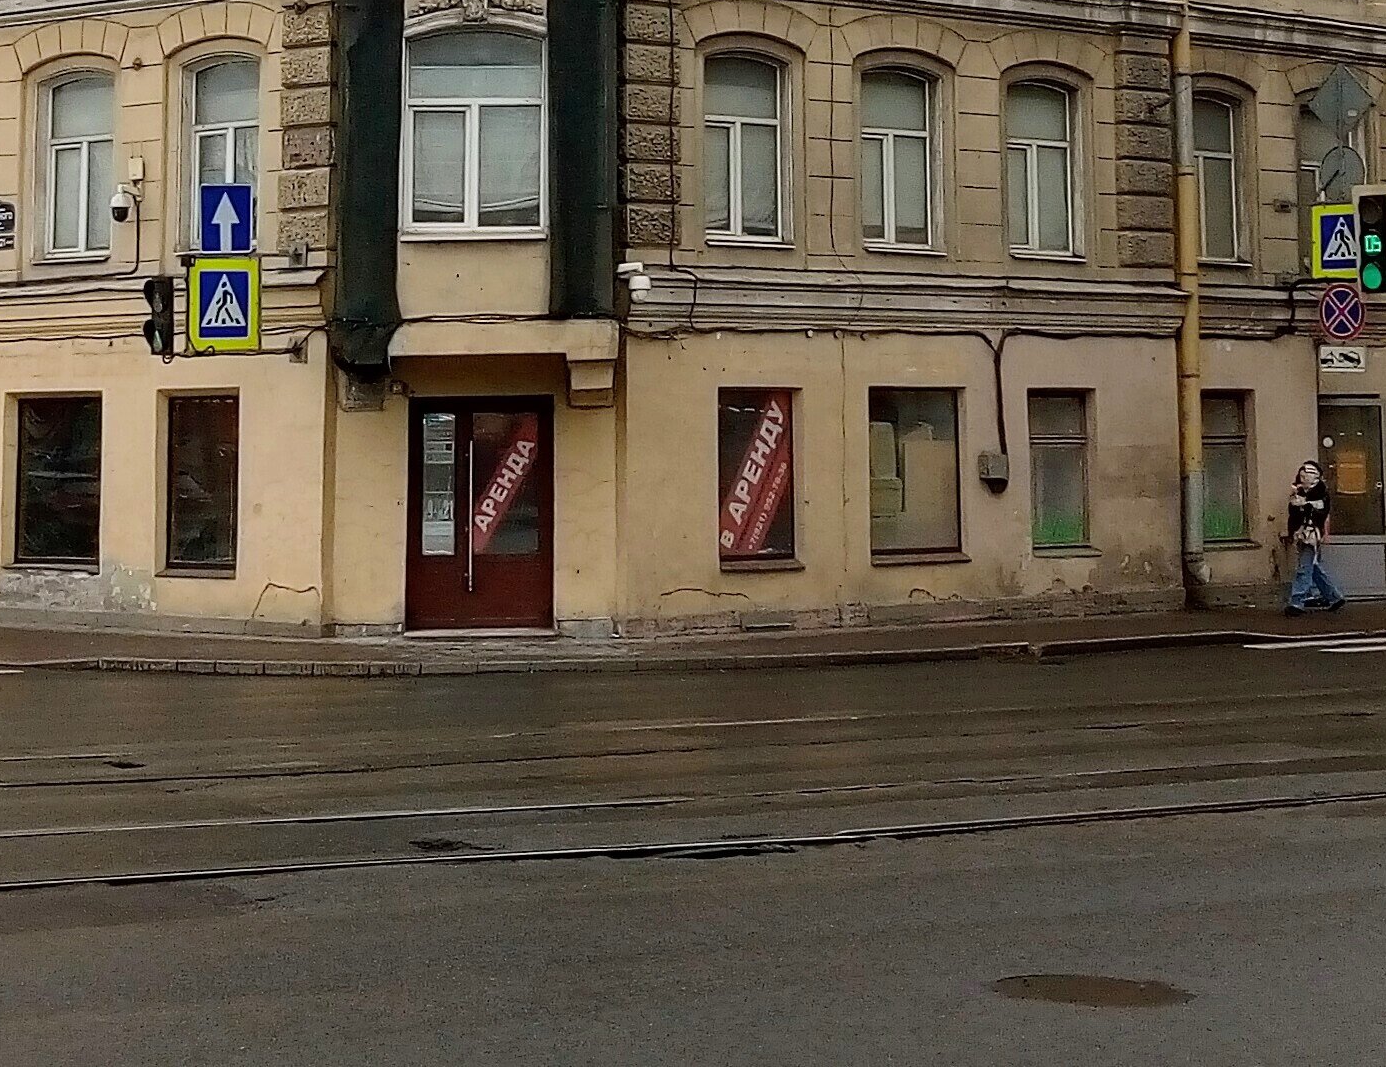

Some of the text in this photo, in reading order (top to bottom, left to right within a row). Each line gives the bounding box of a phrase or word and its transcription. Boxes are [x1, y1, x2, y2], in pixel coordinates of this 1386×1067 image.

[474, 440, 536, 533] АРЕНДА
[720, 400, 784, 549] В АРЕНДУ
